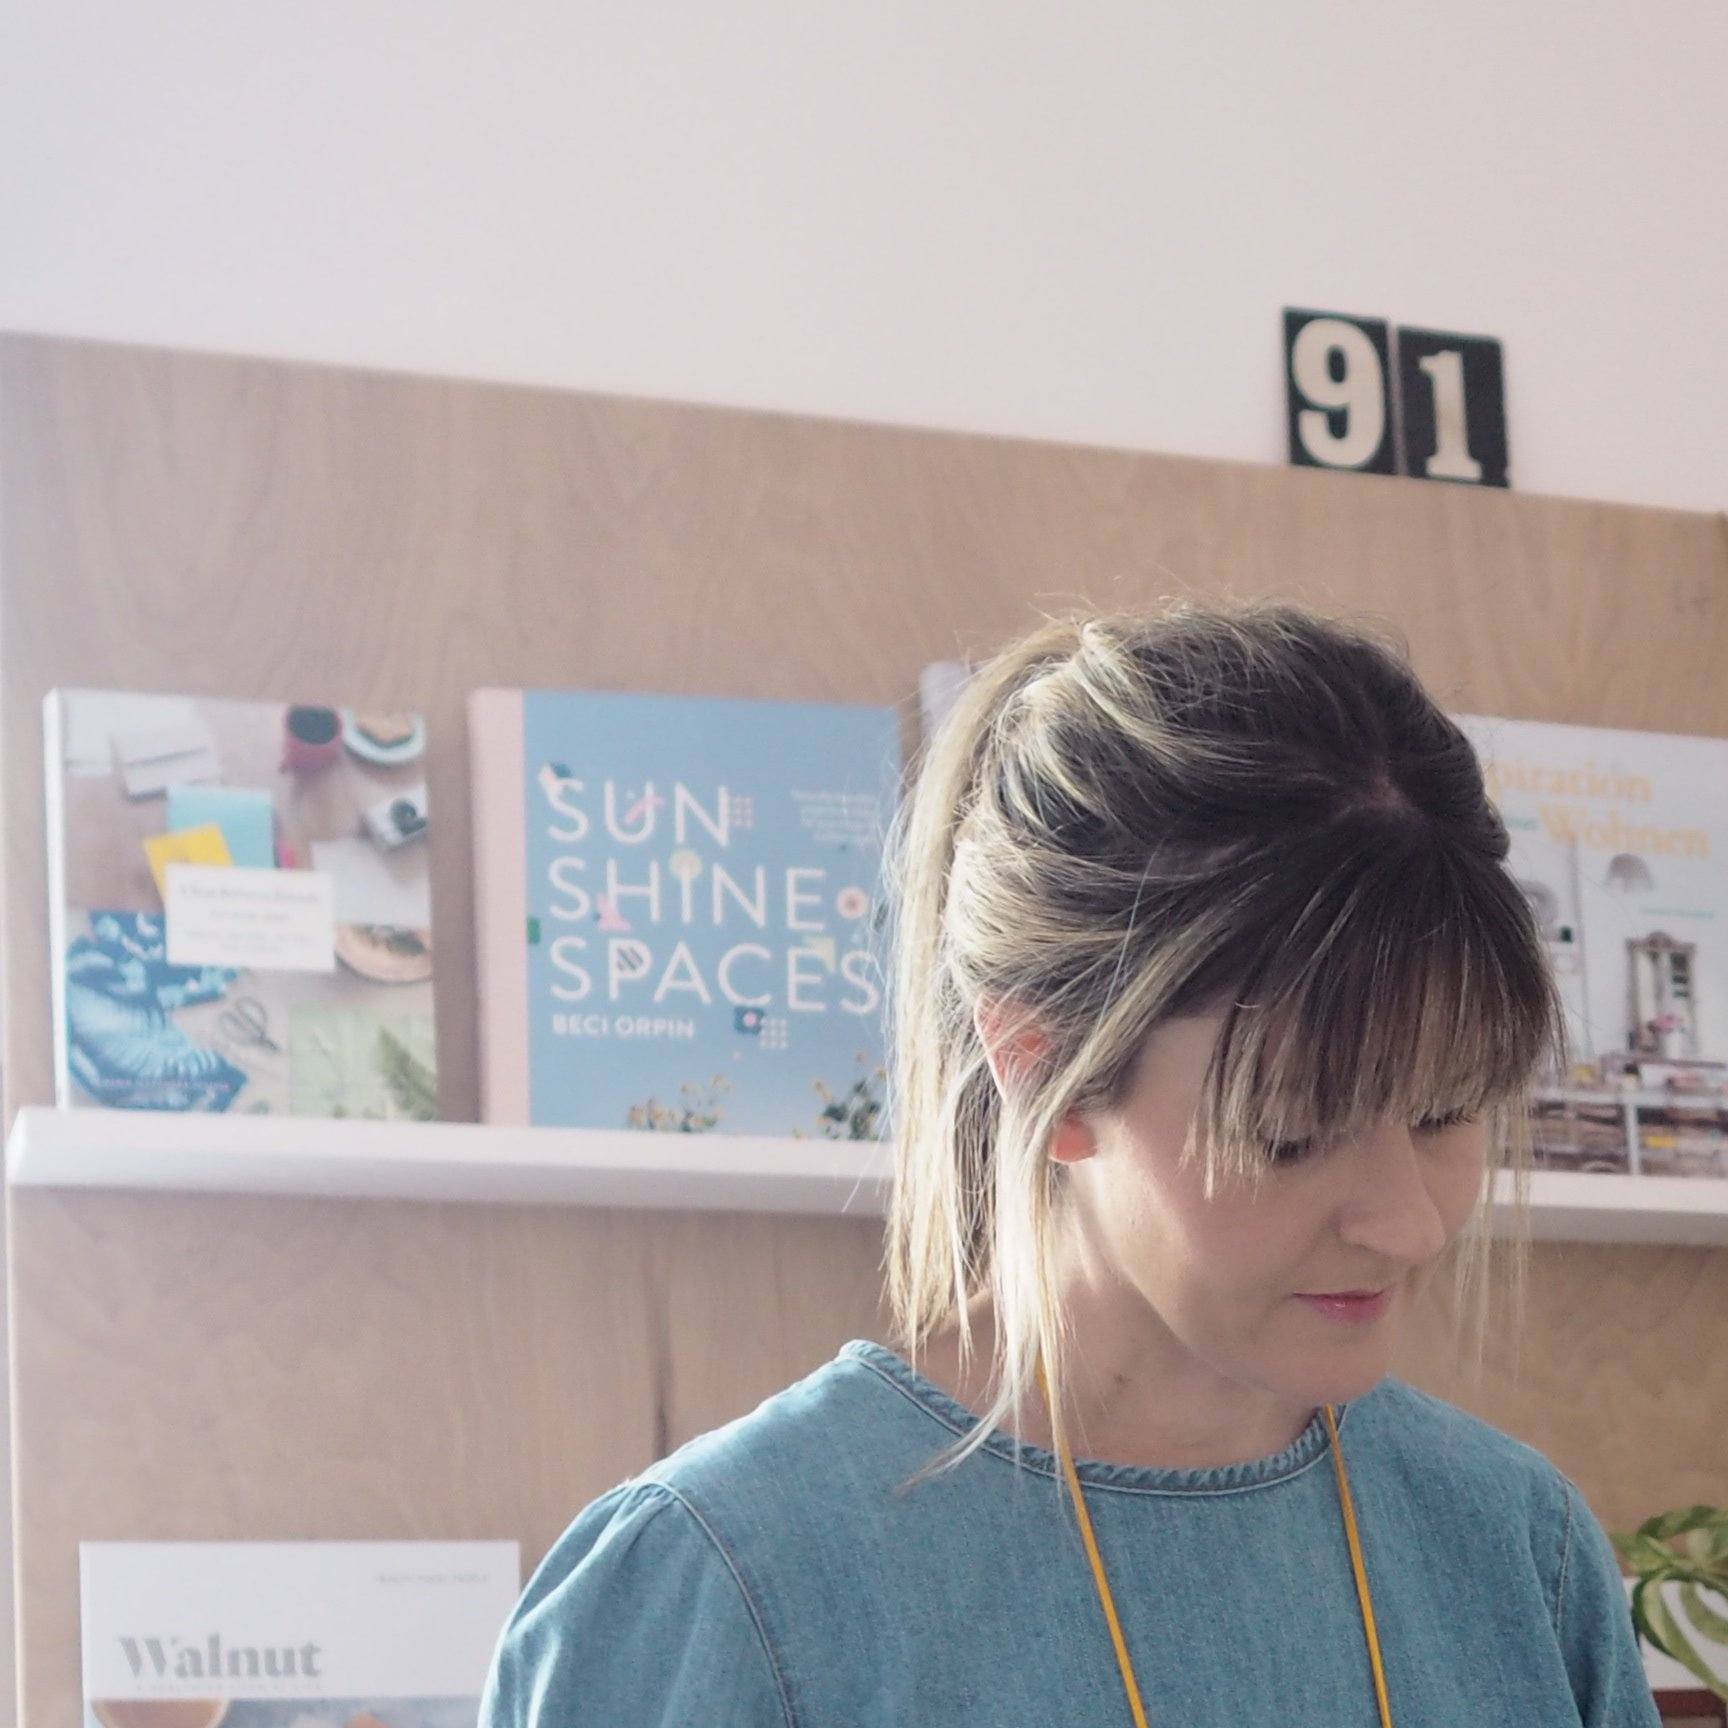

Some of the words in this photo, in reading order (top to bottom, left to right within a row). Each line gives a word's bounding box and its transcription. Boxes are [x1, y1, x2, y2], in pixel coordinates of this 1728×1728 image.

[1291, 316, 1482, 482] 91
[546, 776, 730, 847] SUN
[547, 854, 827, 931] SHINE
[548, 936, 881, 1015] SPACES
[552, 1013, 609, 1037] BECI
[614, 1015, 695, 1040] ORPIN
[117, 1632, 322, 1679] Walnut
